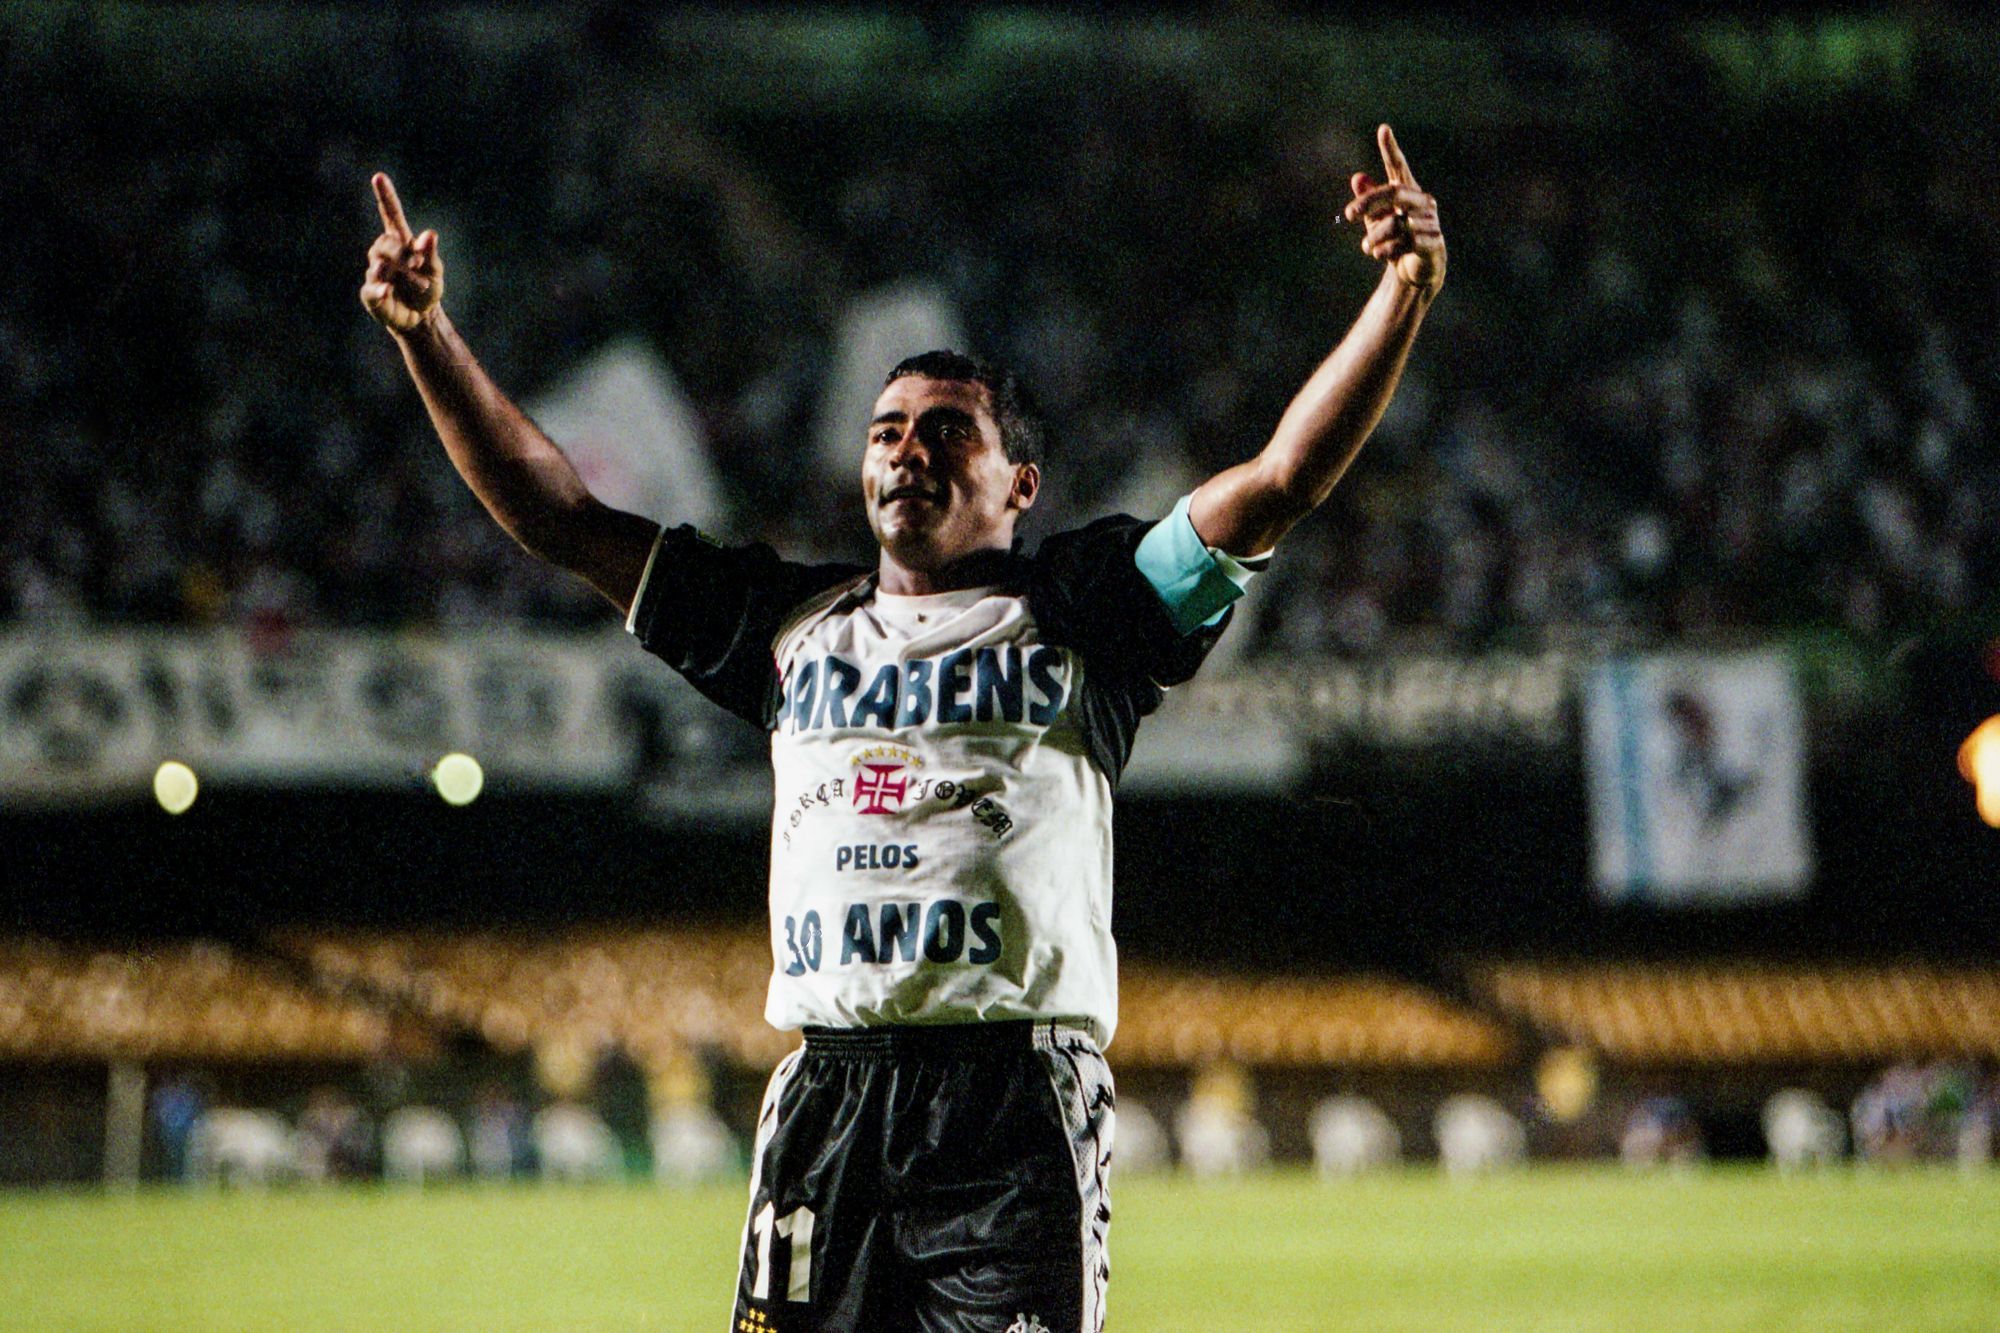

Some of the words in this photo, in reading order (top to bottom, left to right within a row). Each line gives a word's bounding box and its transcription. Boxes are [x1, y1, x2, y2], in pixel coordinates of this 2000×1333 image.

[836, 844, 919, 871] PELOS
[785, 909, 822, 976] 30
[840, 901, 1002, 966] ANOS
[752, 1201, 815, 1302] 11
